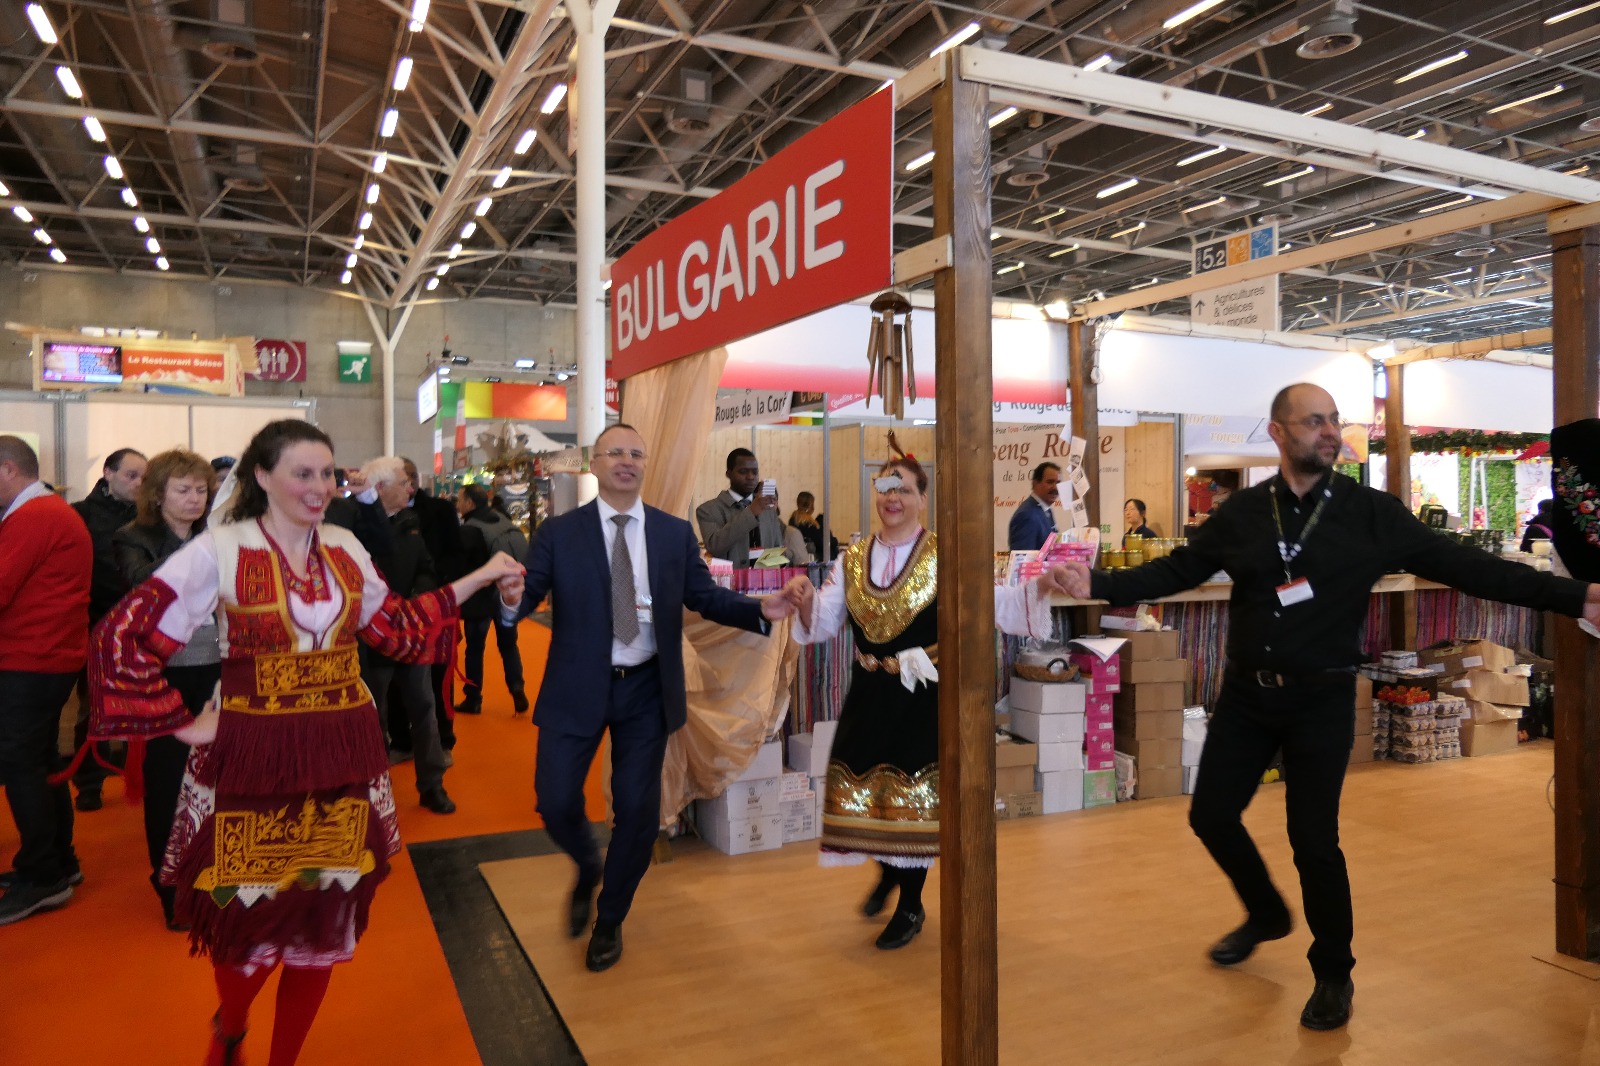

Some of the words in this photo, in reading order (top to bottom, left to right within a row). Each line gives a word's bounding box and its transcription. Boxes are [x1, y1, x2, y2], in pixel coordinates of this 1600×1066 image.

[617, 159, 845, 352] BULGARIE
[1202, 247, 1226, 270] 5.2
[1214, 286, 1265, 306] Agricultures
[1214, 308, 1220, 318] &
[128, 355, 140, 365] Le
[142, 356, 191, 367] Restaurant
[193, 358, 223, 368] Suisse
[715, 406, 739, 424] Rouge
[742, 399, 752, 416] de
[756, 399, 765, 415] la
[1043, 432, 1113, 457] Roe
[1002, 471, 1013, 481] de
[1017, 470, 1025, 481] la
